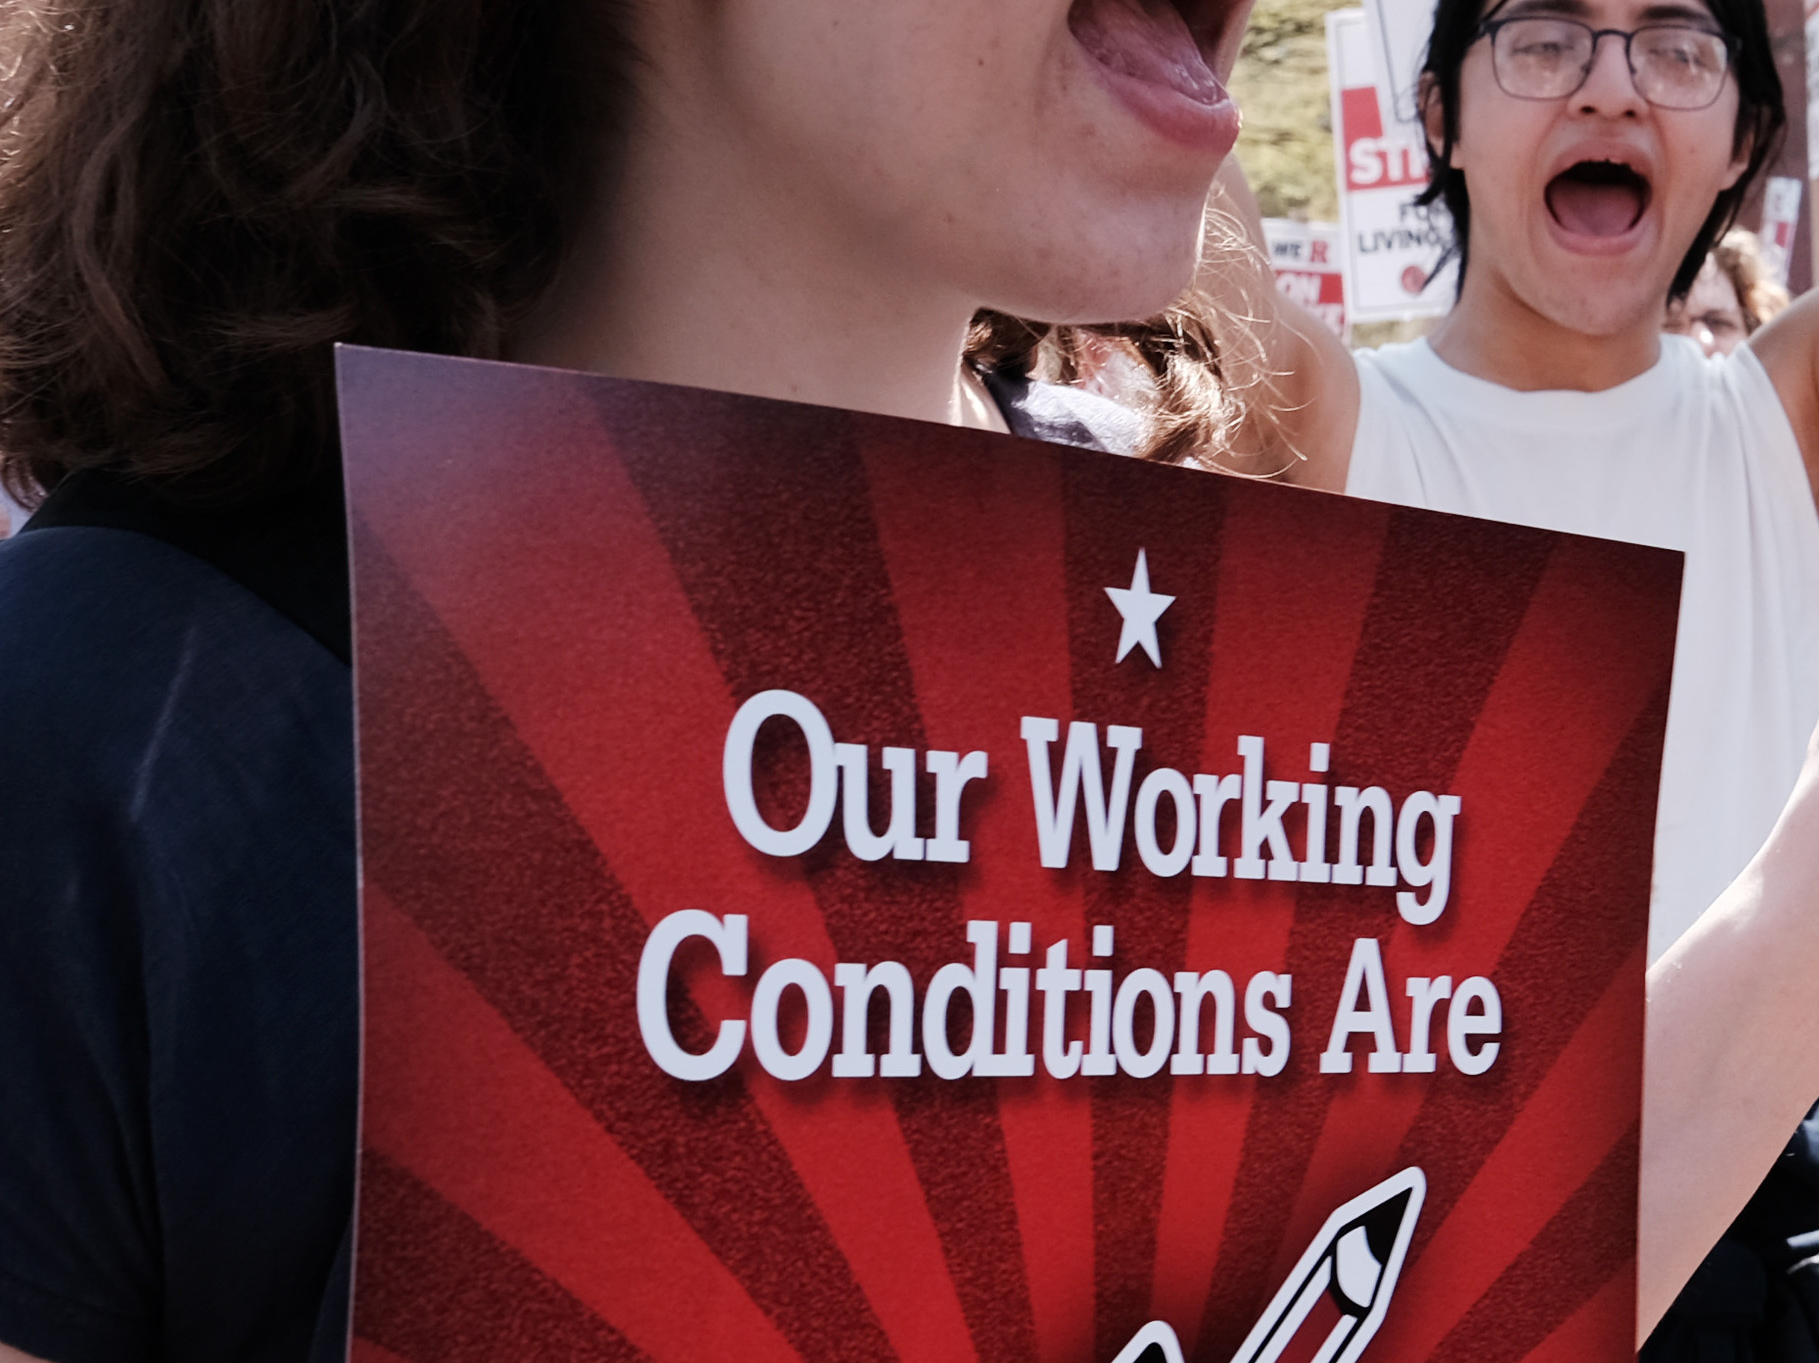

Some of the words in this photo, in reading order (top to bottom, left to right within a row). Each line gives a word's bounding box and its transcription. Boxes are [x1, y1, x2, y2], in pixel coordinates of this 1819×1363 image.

[721, 688, 989, 863] Our
[1019, 714, 1461, 926] Working
[636, 908, 1292, 1083] Conditions
[1319, 936, 1503, 1077] Are
